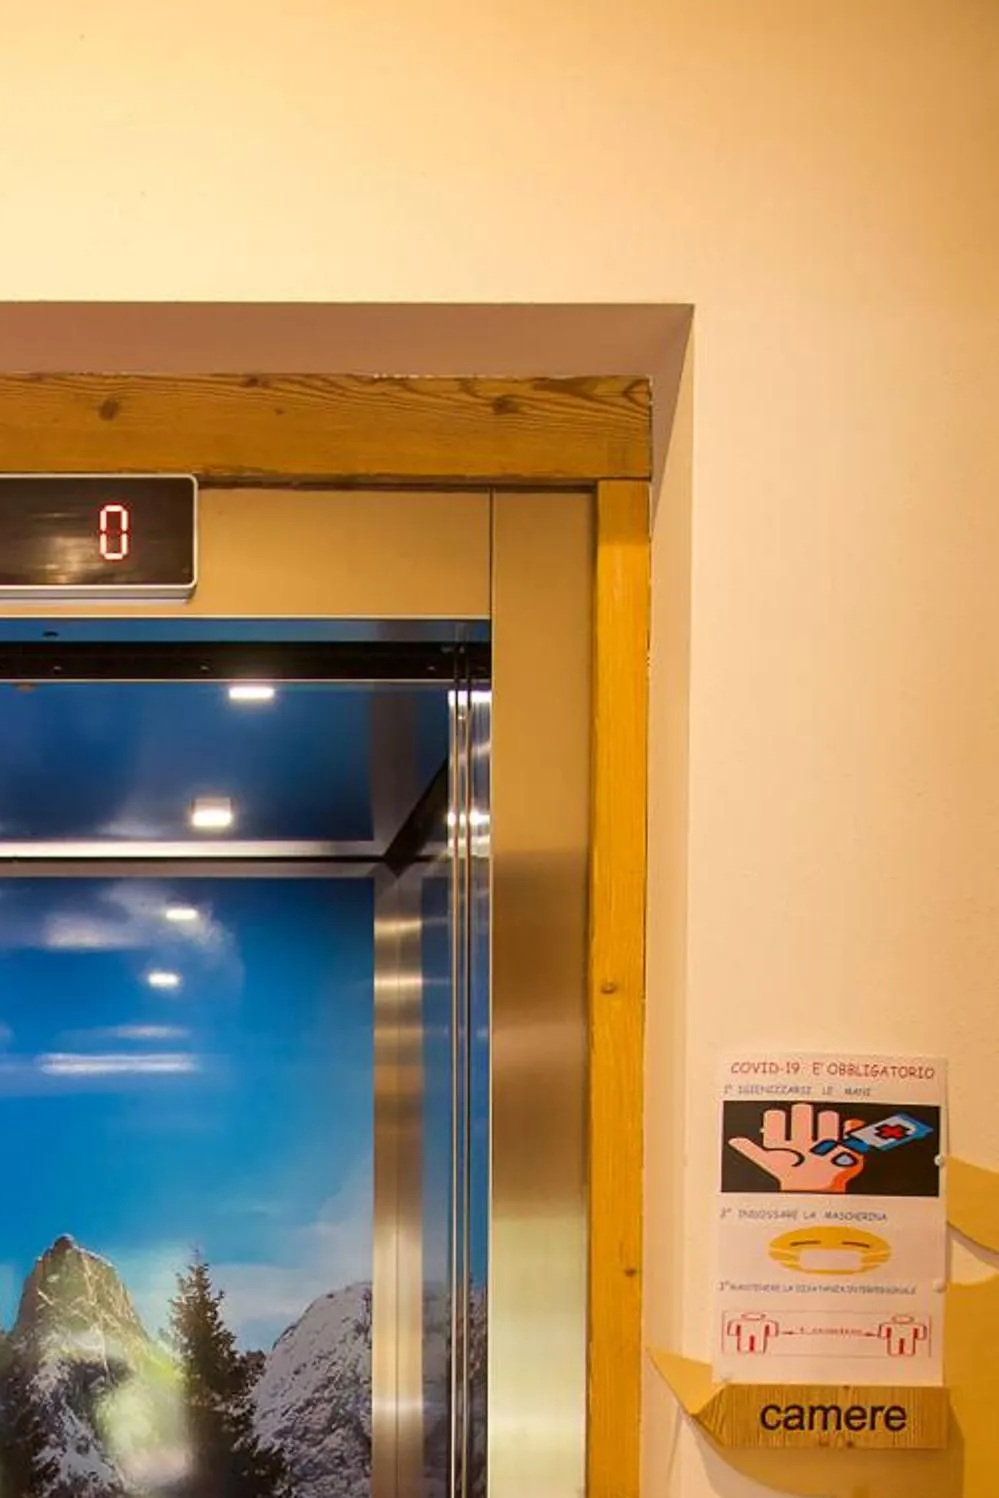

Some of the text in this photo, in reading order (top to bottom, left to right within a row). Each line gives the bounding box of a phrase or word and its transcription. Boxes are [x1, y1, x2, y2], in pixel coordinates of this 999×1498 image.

[100, 504, 129, 560] 0
[730, 1062, 800, 1075] COVID-19
[826, 1063, 936, 1080] OBBLIGATORIO
[760, 1404, 908, 1432] camere
